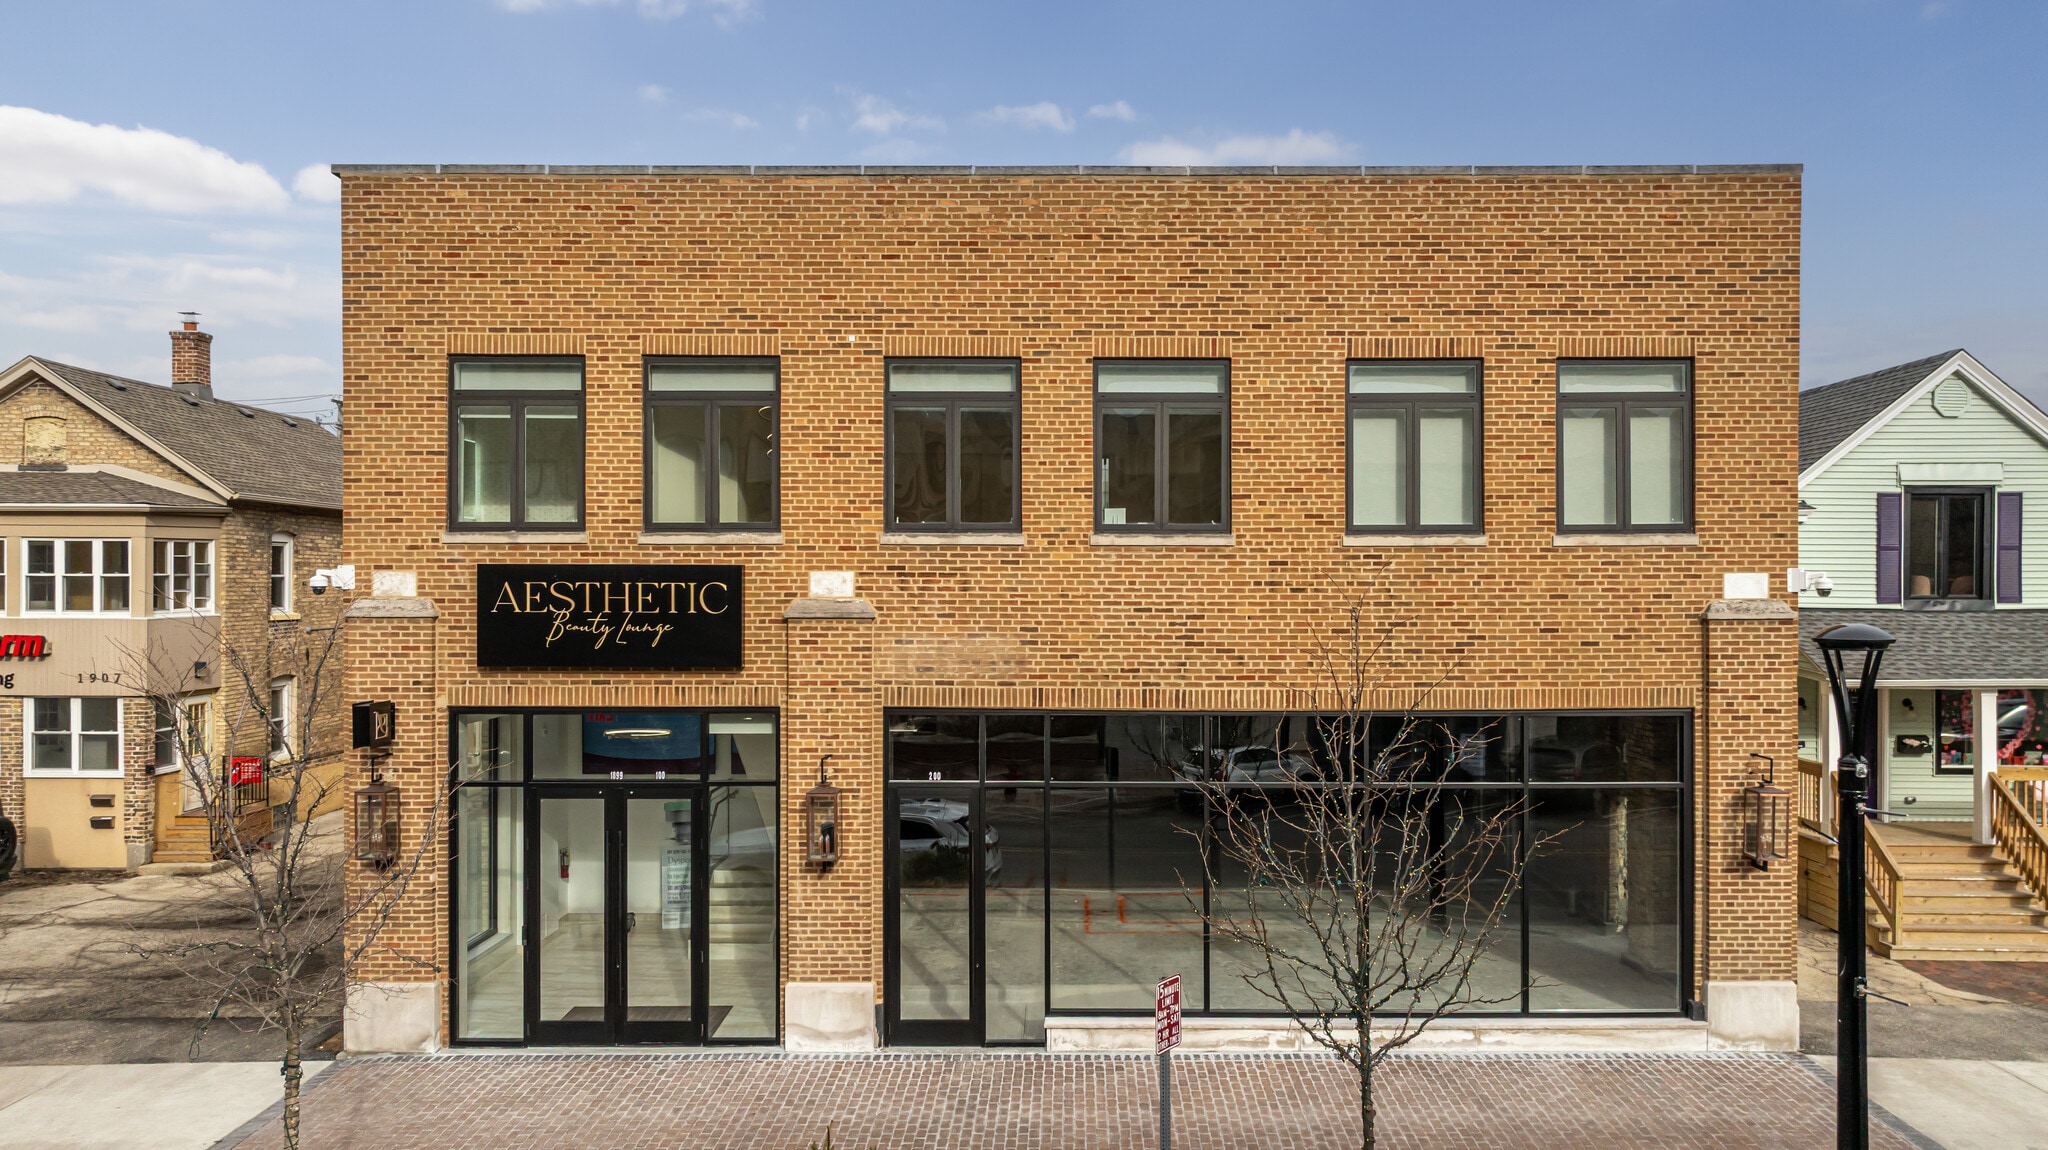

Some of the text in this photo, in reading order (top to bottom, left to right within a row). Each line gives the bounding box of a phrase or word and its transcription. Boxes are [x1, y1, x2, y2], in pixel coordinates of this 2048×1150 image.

[491, 581, 729, 614] AESTHETIC
[545, 607, 674, 650] Beauty Lounge
[78, 673, 121, 684] 1907
[610, 771, 624, 780] 1899
[655, 771, 666, 780] 100
[928, 771, 942, 780] 200
[1157, 982, 1179, 1000] 15 MINUTE
[1162, 994, 1174, 1008] LIMIT
